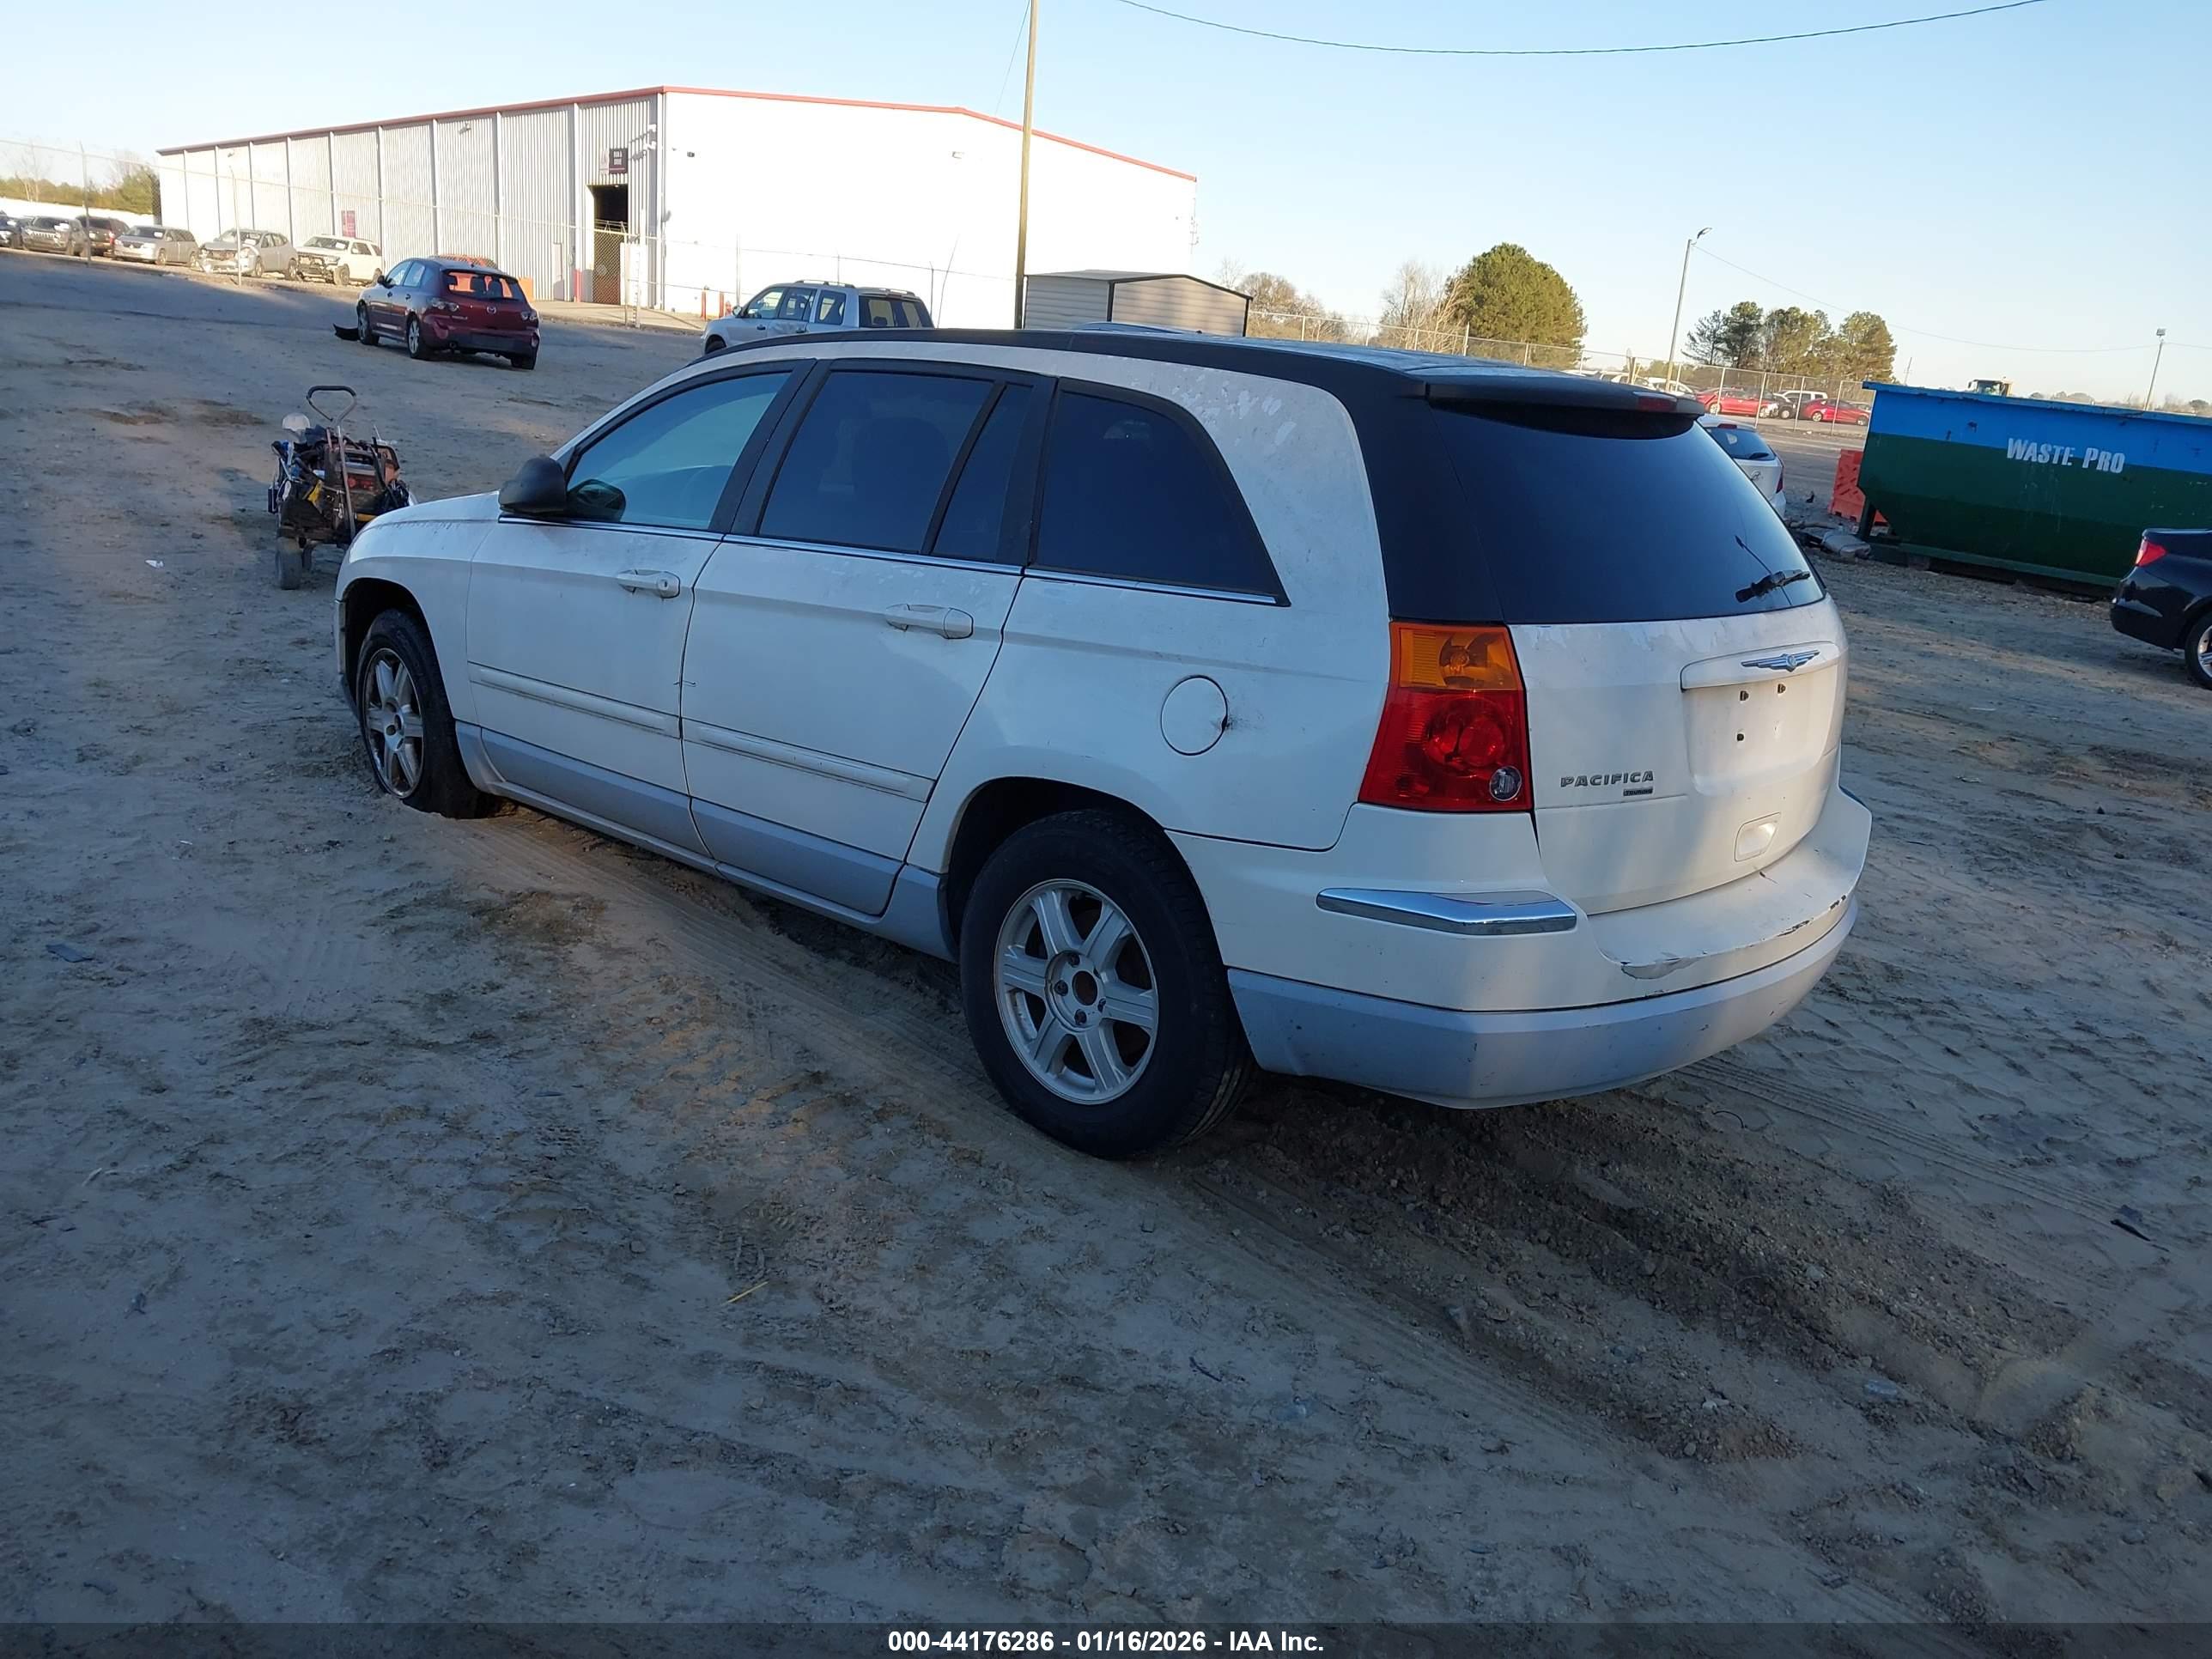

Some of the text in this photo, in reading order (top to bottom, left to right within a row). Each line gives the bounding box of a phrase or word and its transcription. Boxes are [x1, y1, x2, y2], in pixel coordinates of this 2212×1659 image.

[2007, 438, 2125, 473] WASTE PRO
[1561, 771, 1654, 787] PACIFICA
